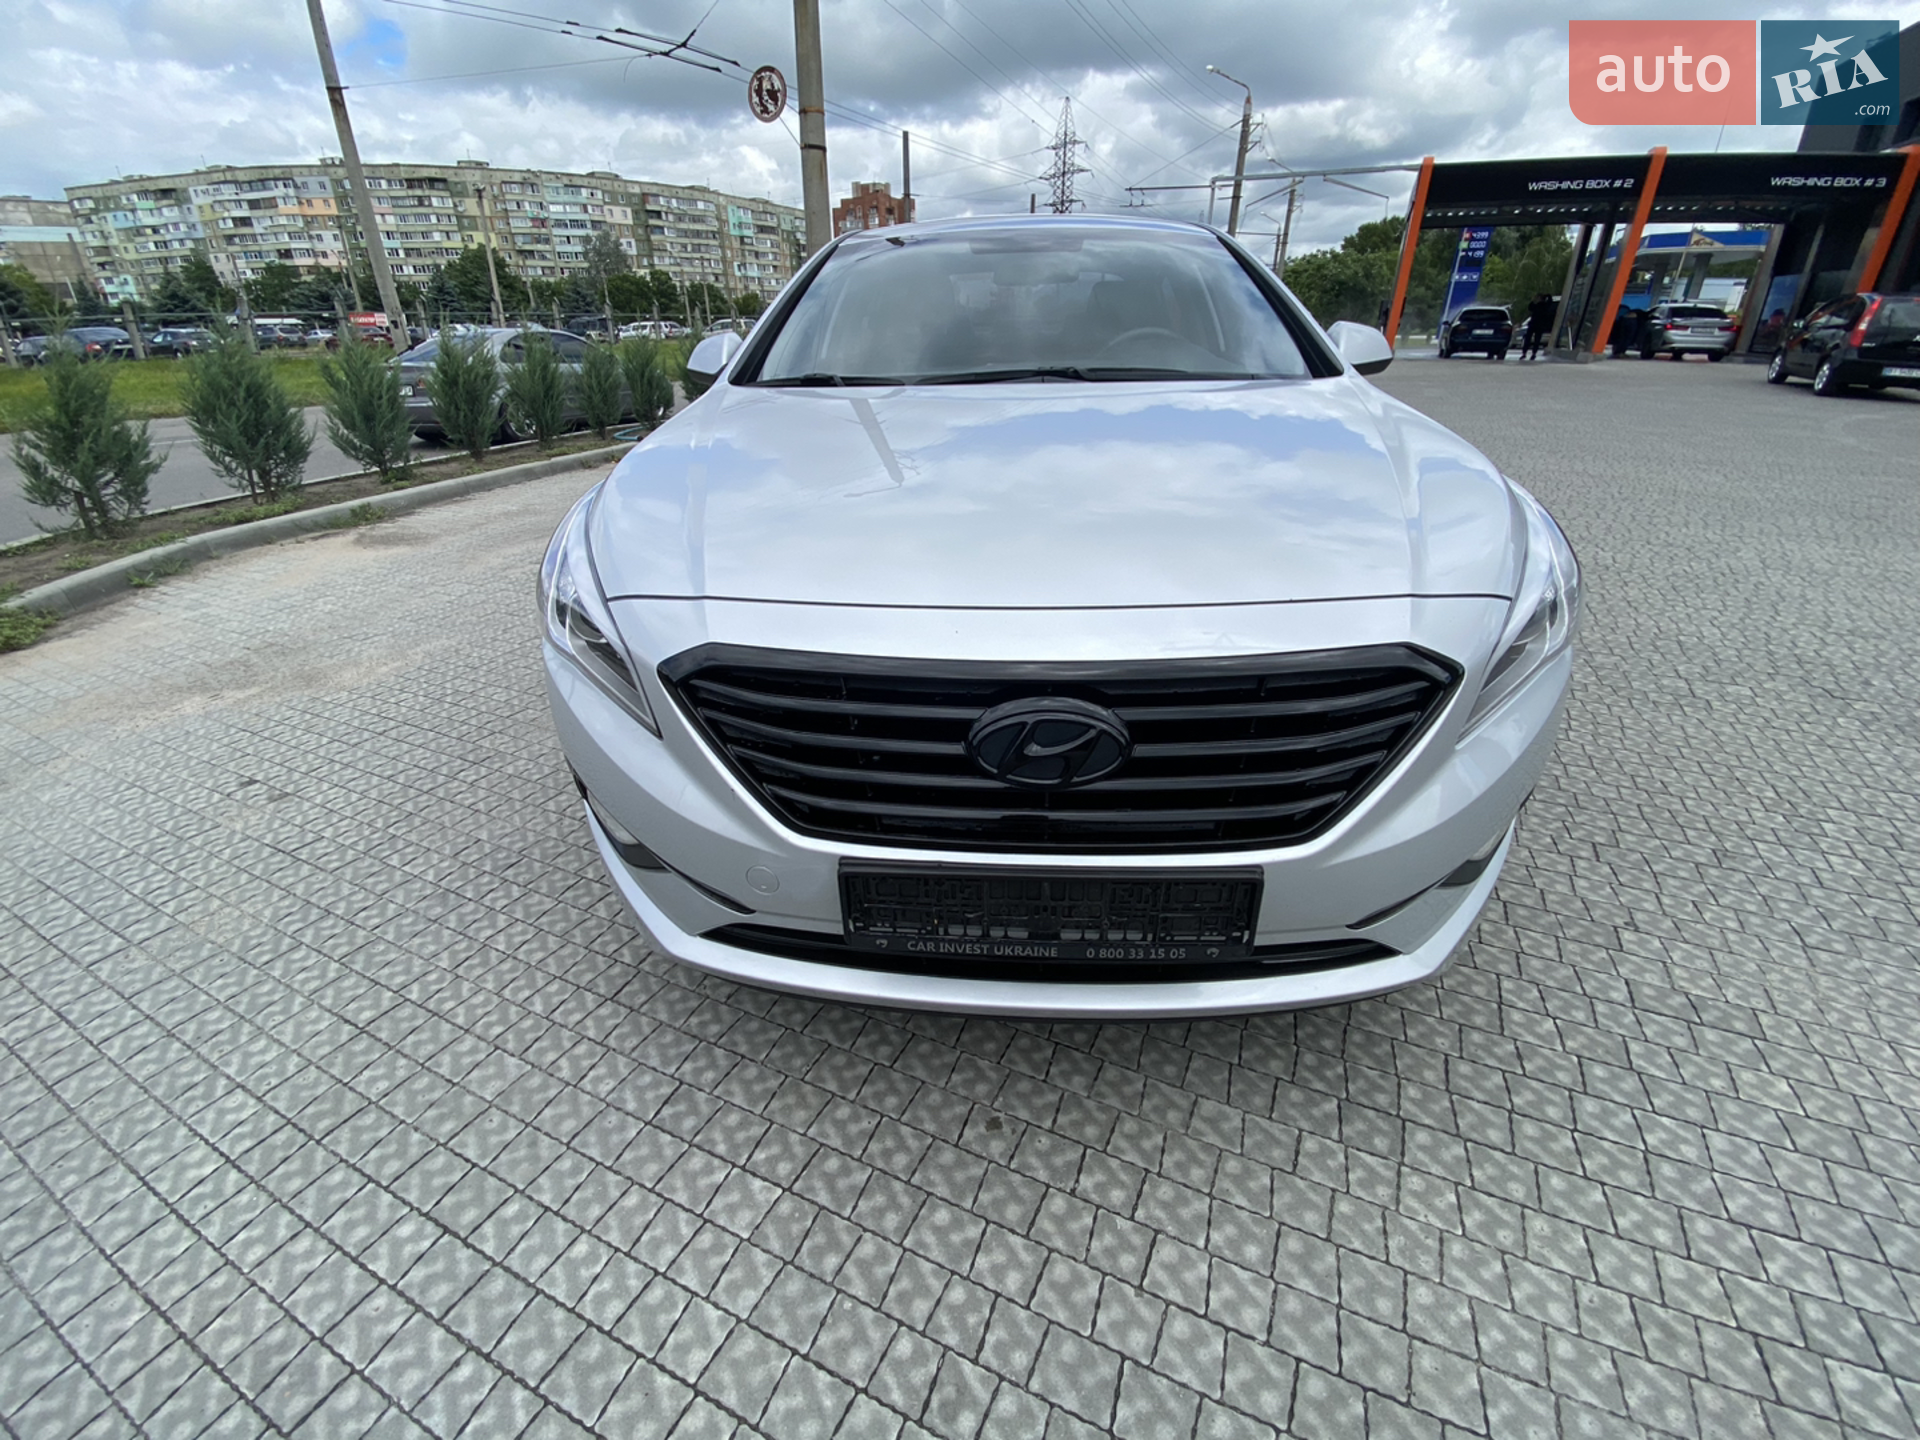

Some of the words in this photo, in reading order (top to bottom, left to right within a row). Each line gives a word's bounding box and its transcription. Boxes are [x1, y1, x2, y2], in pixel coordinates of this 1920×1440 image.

[1528, 180, 1584, 190] WASHING
[1585, 179, 1611, 188] BOX
[1613, 179, 1623, 188] #
[1623, 178, 1634, 188] 2
[1771, 176, 1832, 187] WASHING
[1833, 176, 1862, 187] BOX
[1864, 178, 1875, 187] #
[1875, 177, 1886, 187] 3
[907, 940, 936, 952] CAR
[939, 941, 990, 955] INVEST
[994, 945, 1058, 957] UKRAINE
[1086, 947, 1095, 959] 0
[1099, 947, 1124, 959] 800
[1128, 948, 1144, 959] 33
[1150, 948, 1165, 959] 15
[1169, 948, 1186, 959] 05
